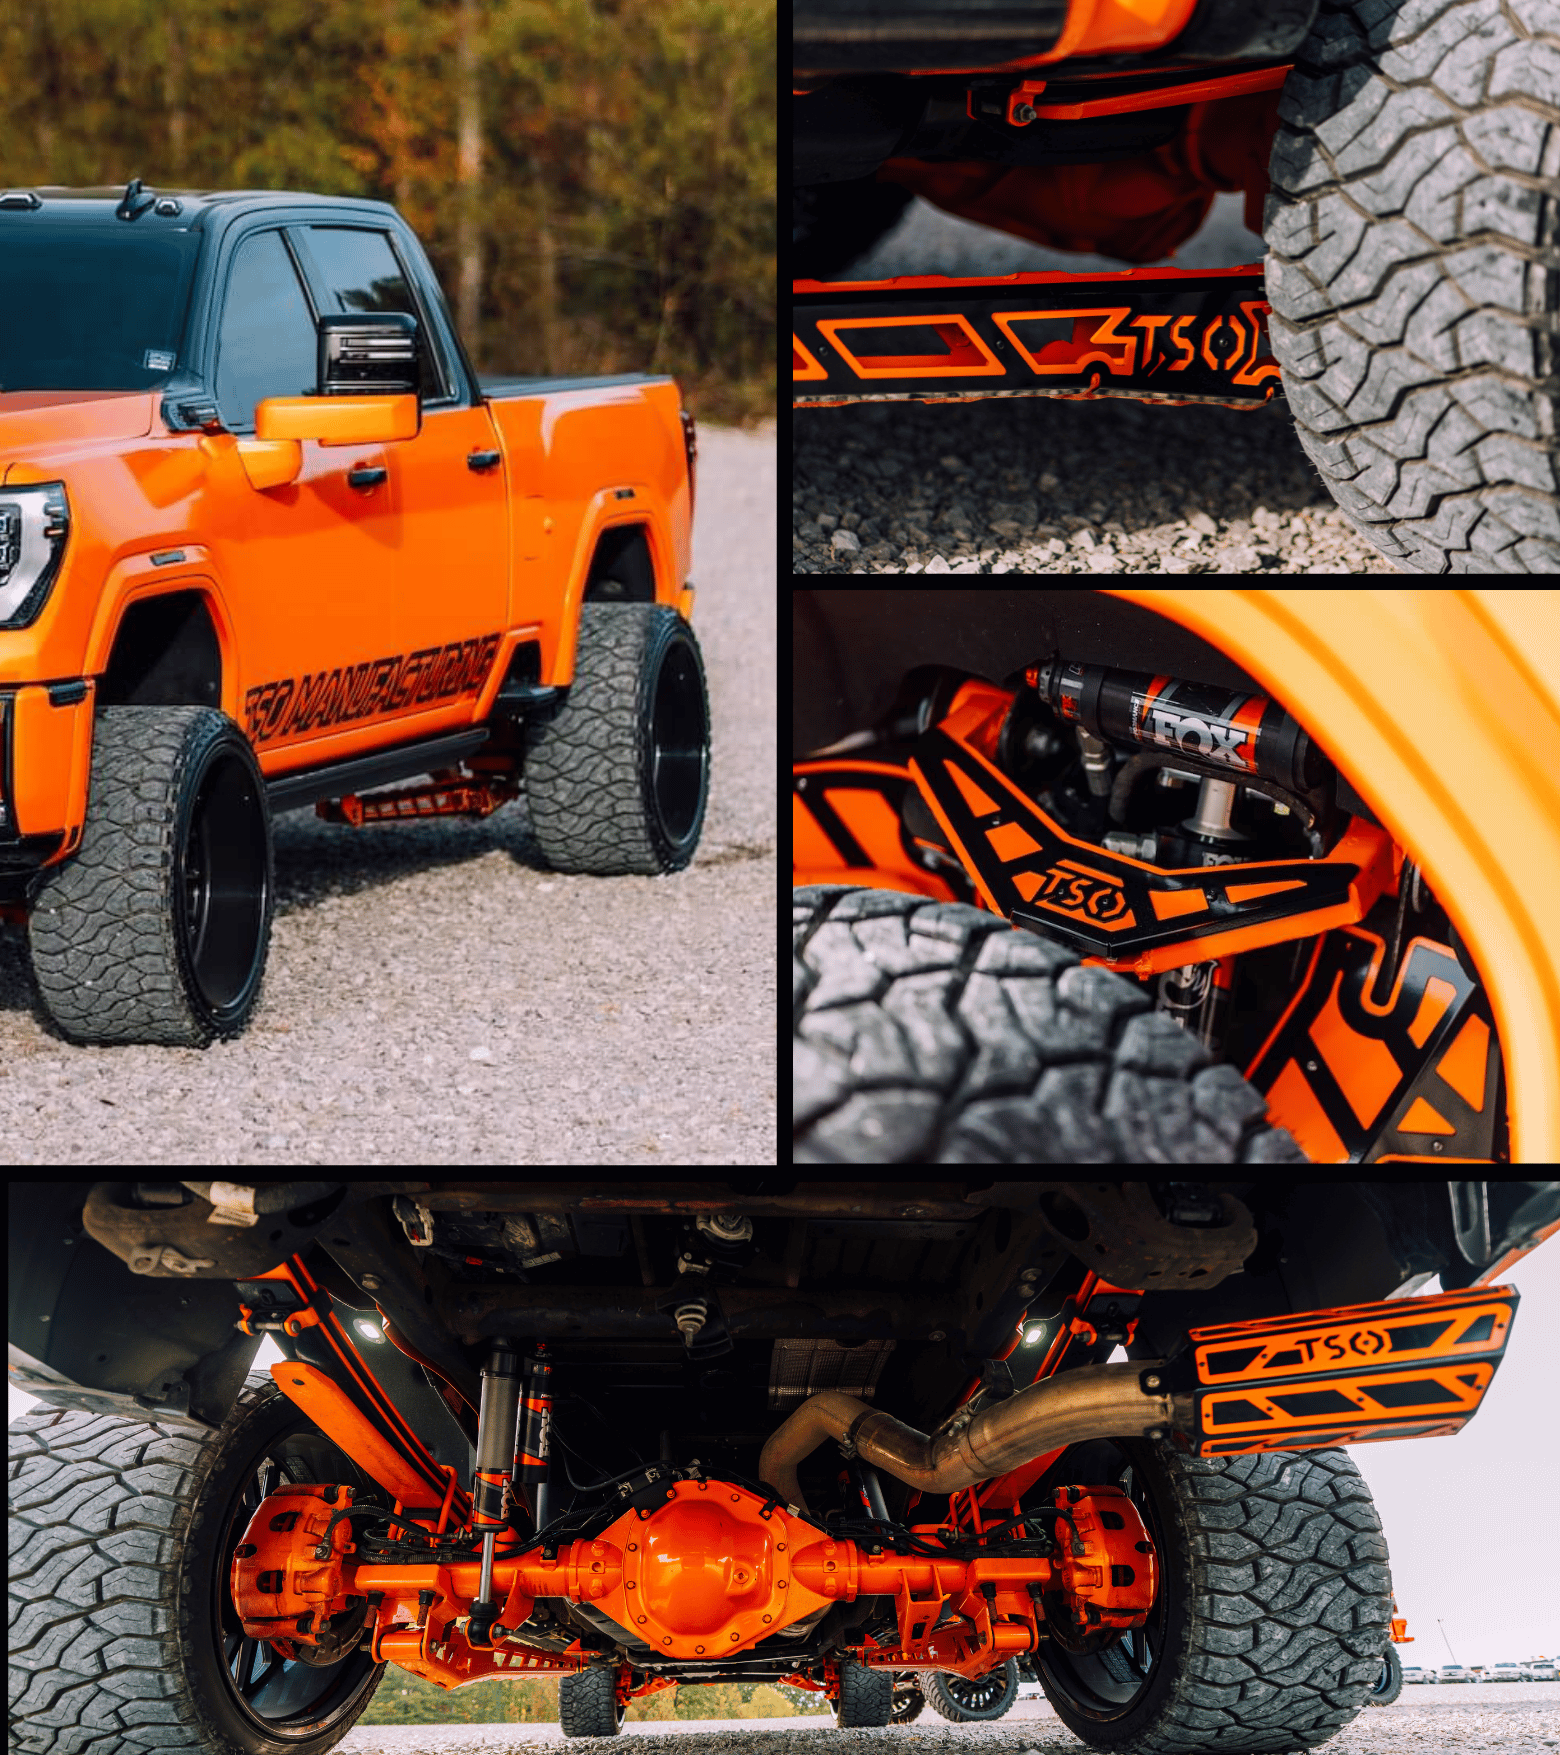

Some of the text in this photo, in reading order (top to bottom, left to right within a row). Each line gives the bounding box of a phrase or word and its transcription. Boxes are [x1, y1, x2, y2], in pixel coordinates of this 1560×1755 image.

[1129, 315, 1246, 371] TSO
[1151, 709, 1247, 768] FOX
[1043, 868, 1126, 918] TSO
[1294, 1330, 1385, 1361] TSO
